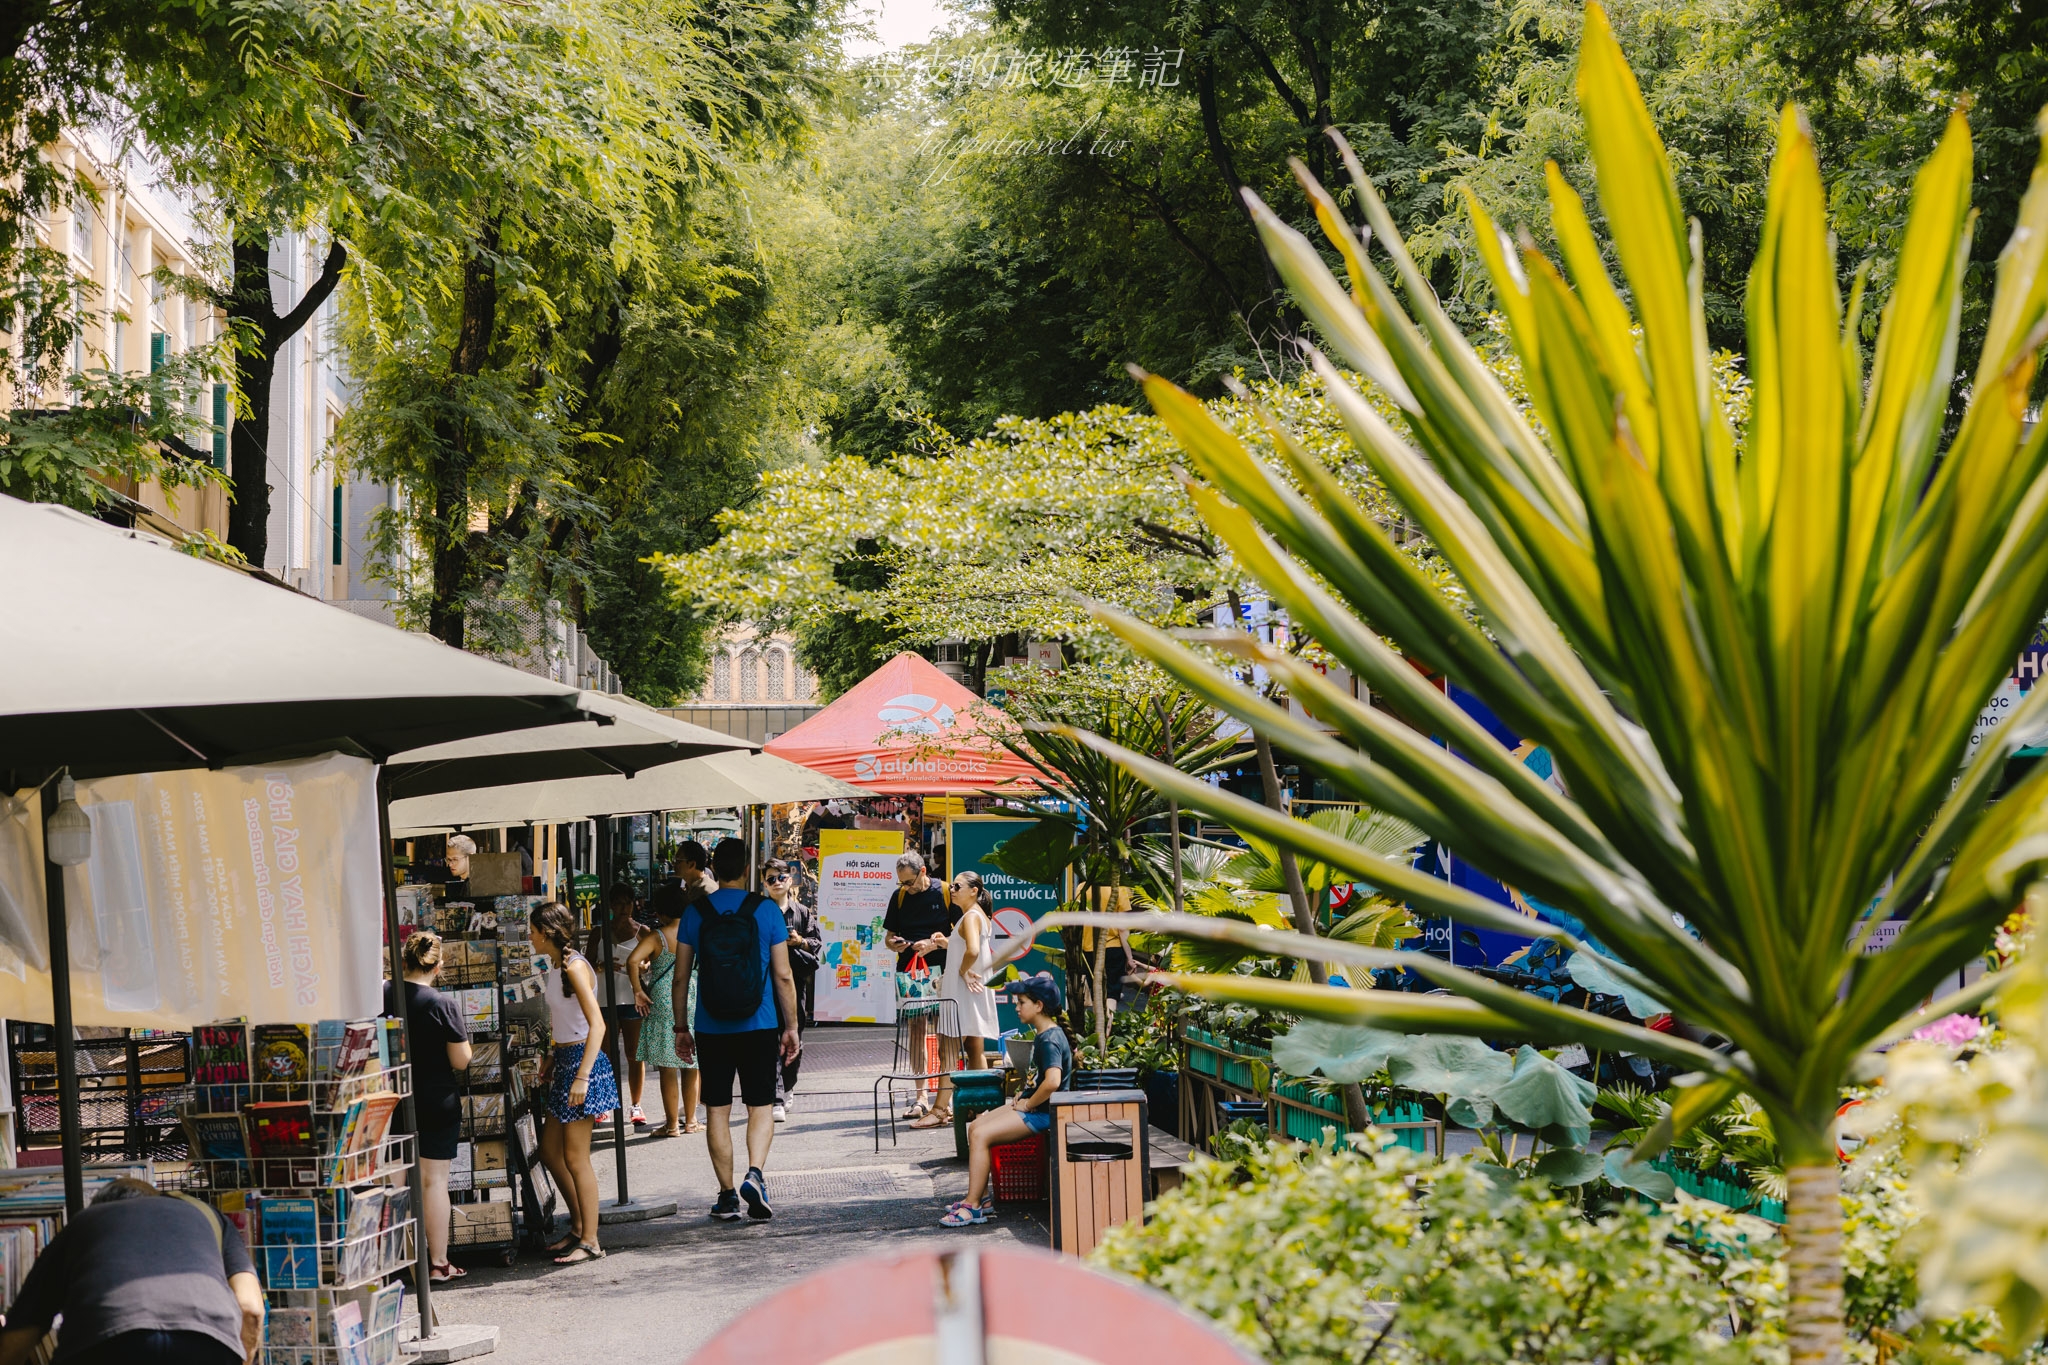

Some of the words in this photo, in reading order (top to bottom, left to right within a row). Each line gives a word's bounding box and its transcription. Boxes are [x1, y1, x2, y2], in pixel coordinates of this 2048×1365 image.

[884, 758, 987, 775] alphabooks
[846, 860, 859, 869] HỘI
[833, 870, 860, 879] ALPHA
[863, 871, 892, 880] BOOKS
[981, 873, 1015, 885] ƯỜNG
[1003, 887, 1042, 900] THUỐC
[201, 1027, 241, 1048] Hey
[272, 1056, 293, 1070] 39
[196, 1061, 250, 1086] right
